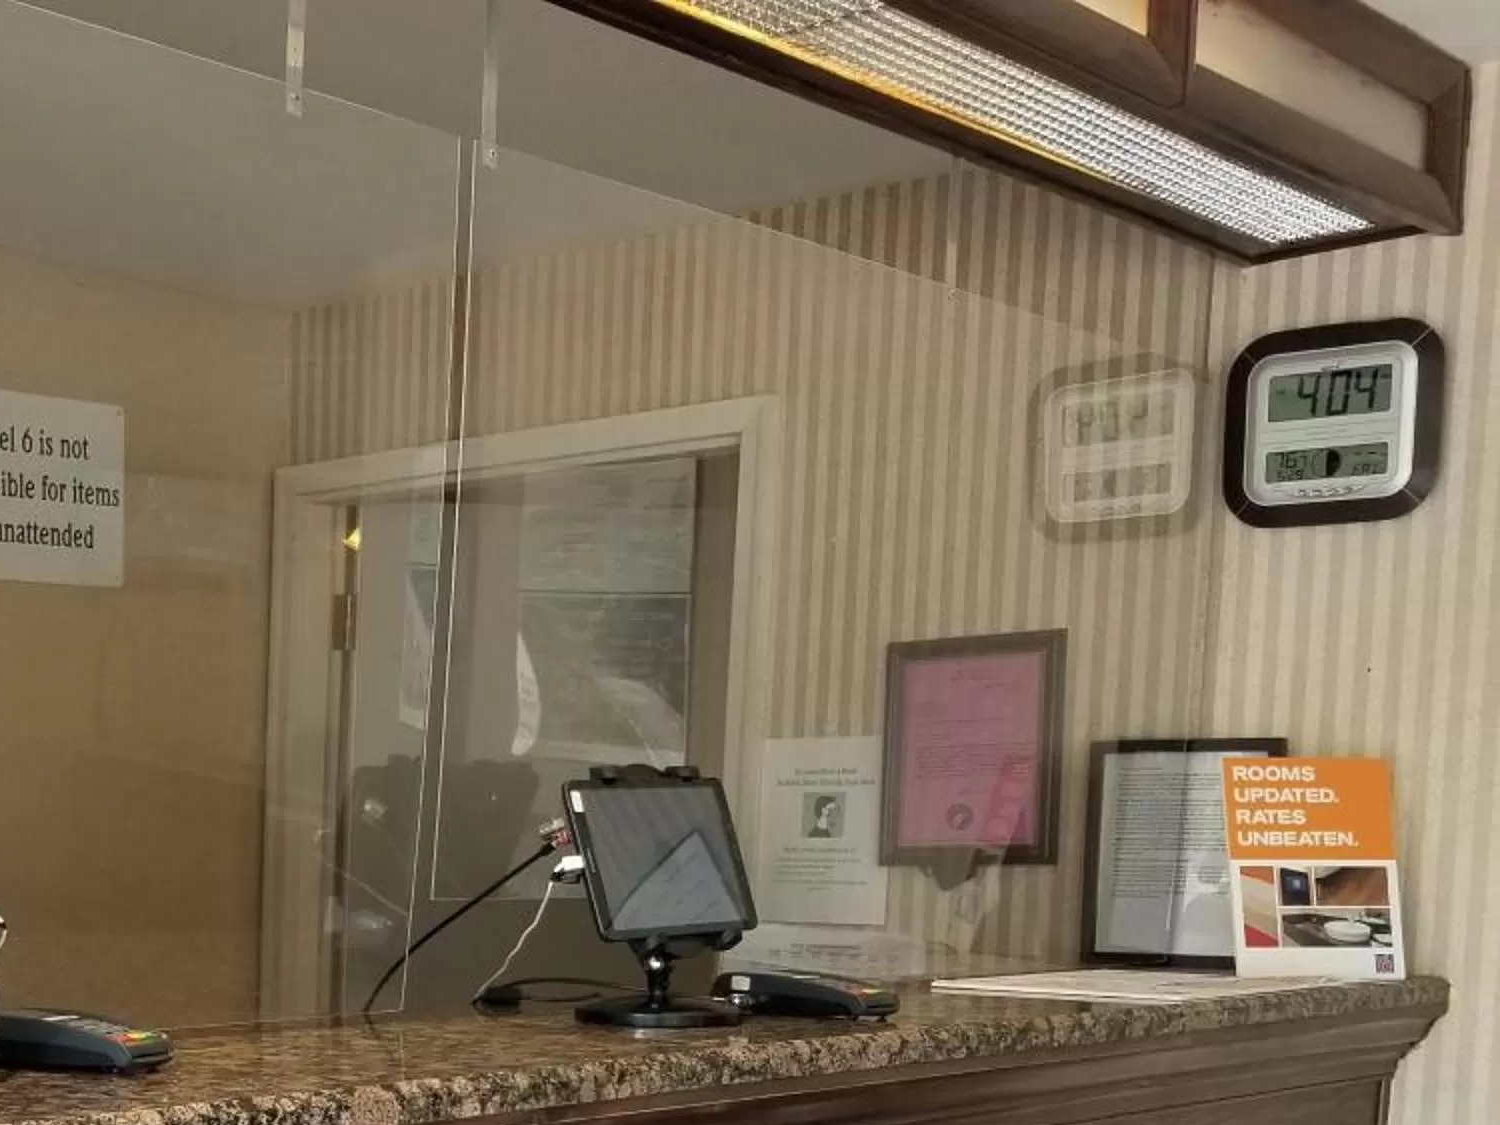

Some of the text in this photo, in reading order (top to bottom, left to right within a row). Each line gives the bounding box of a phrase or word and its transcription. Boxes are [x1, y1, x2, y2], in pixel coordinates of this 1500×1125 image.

[21, 428, 33, 453] 6
[39, 429, 53, 456] is
[59, 437, 90, 460] not
[41, 475, 67, 502] for
[72, 479, 120, 507] items
[1232, 765, 1315, 782] ROOMS
[1234, 787, 1340, 804] UPDATED.
[1235, 808, 1307, 825] RATES
[1237, 831, 1359, 848] UNBEATEN.
